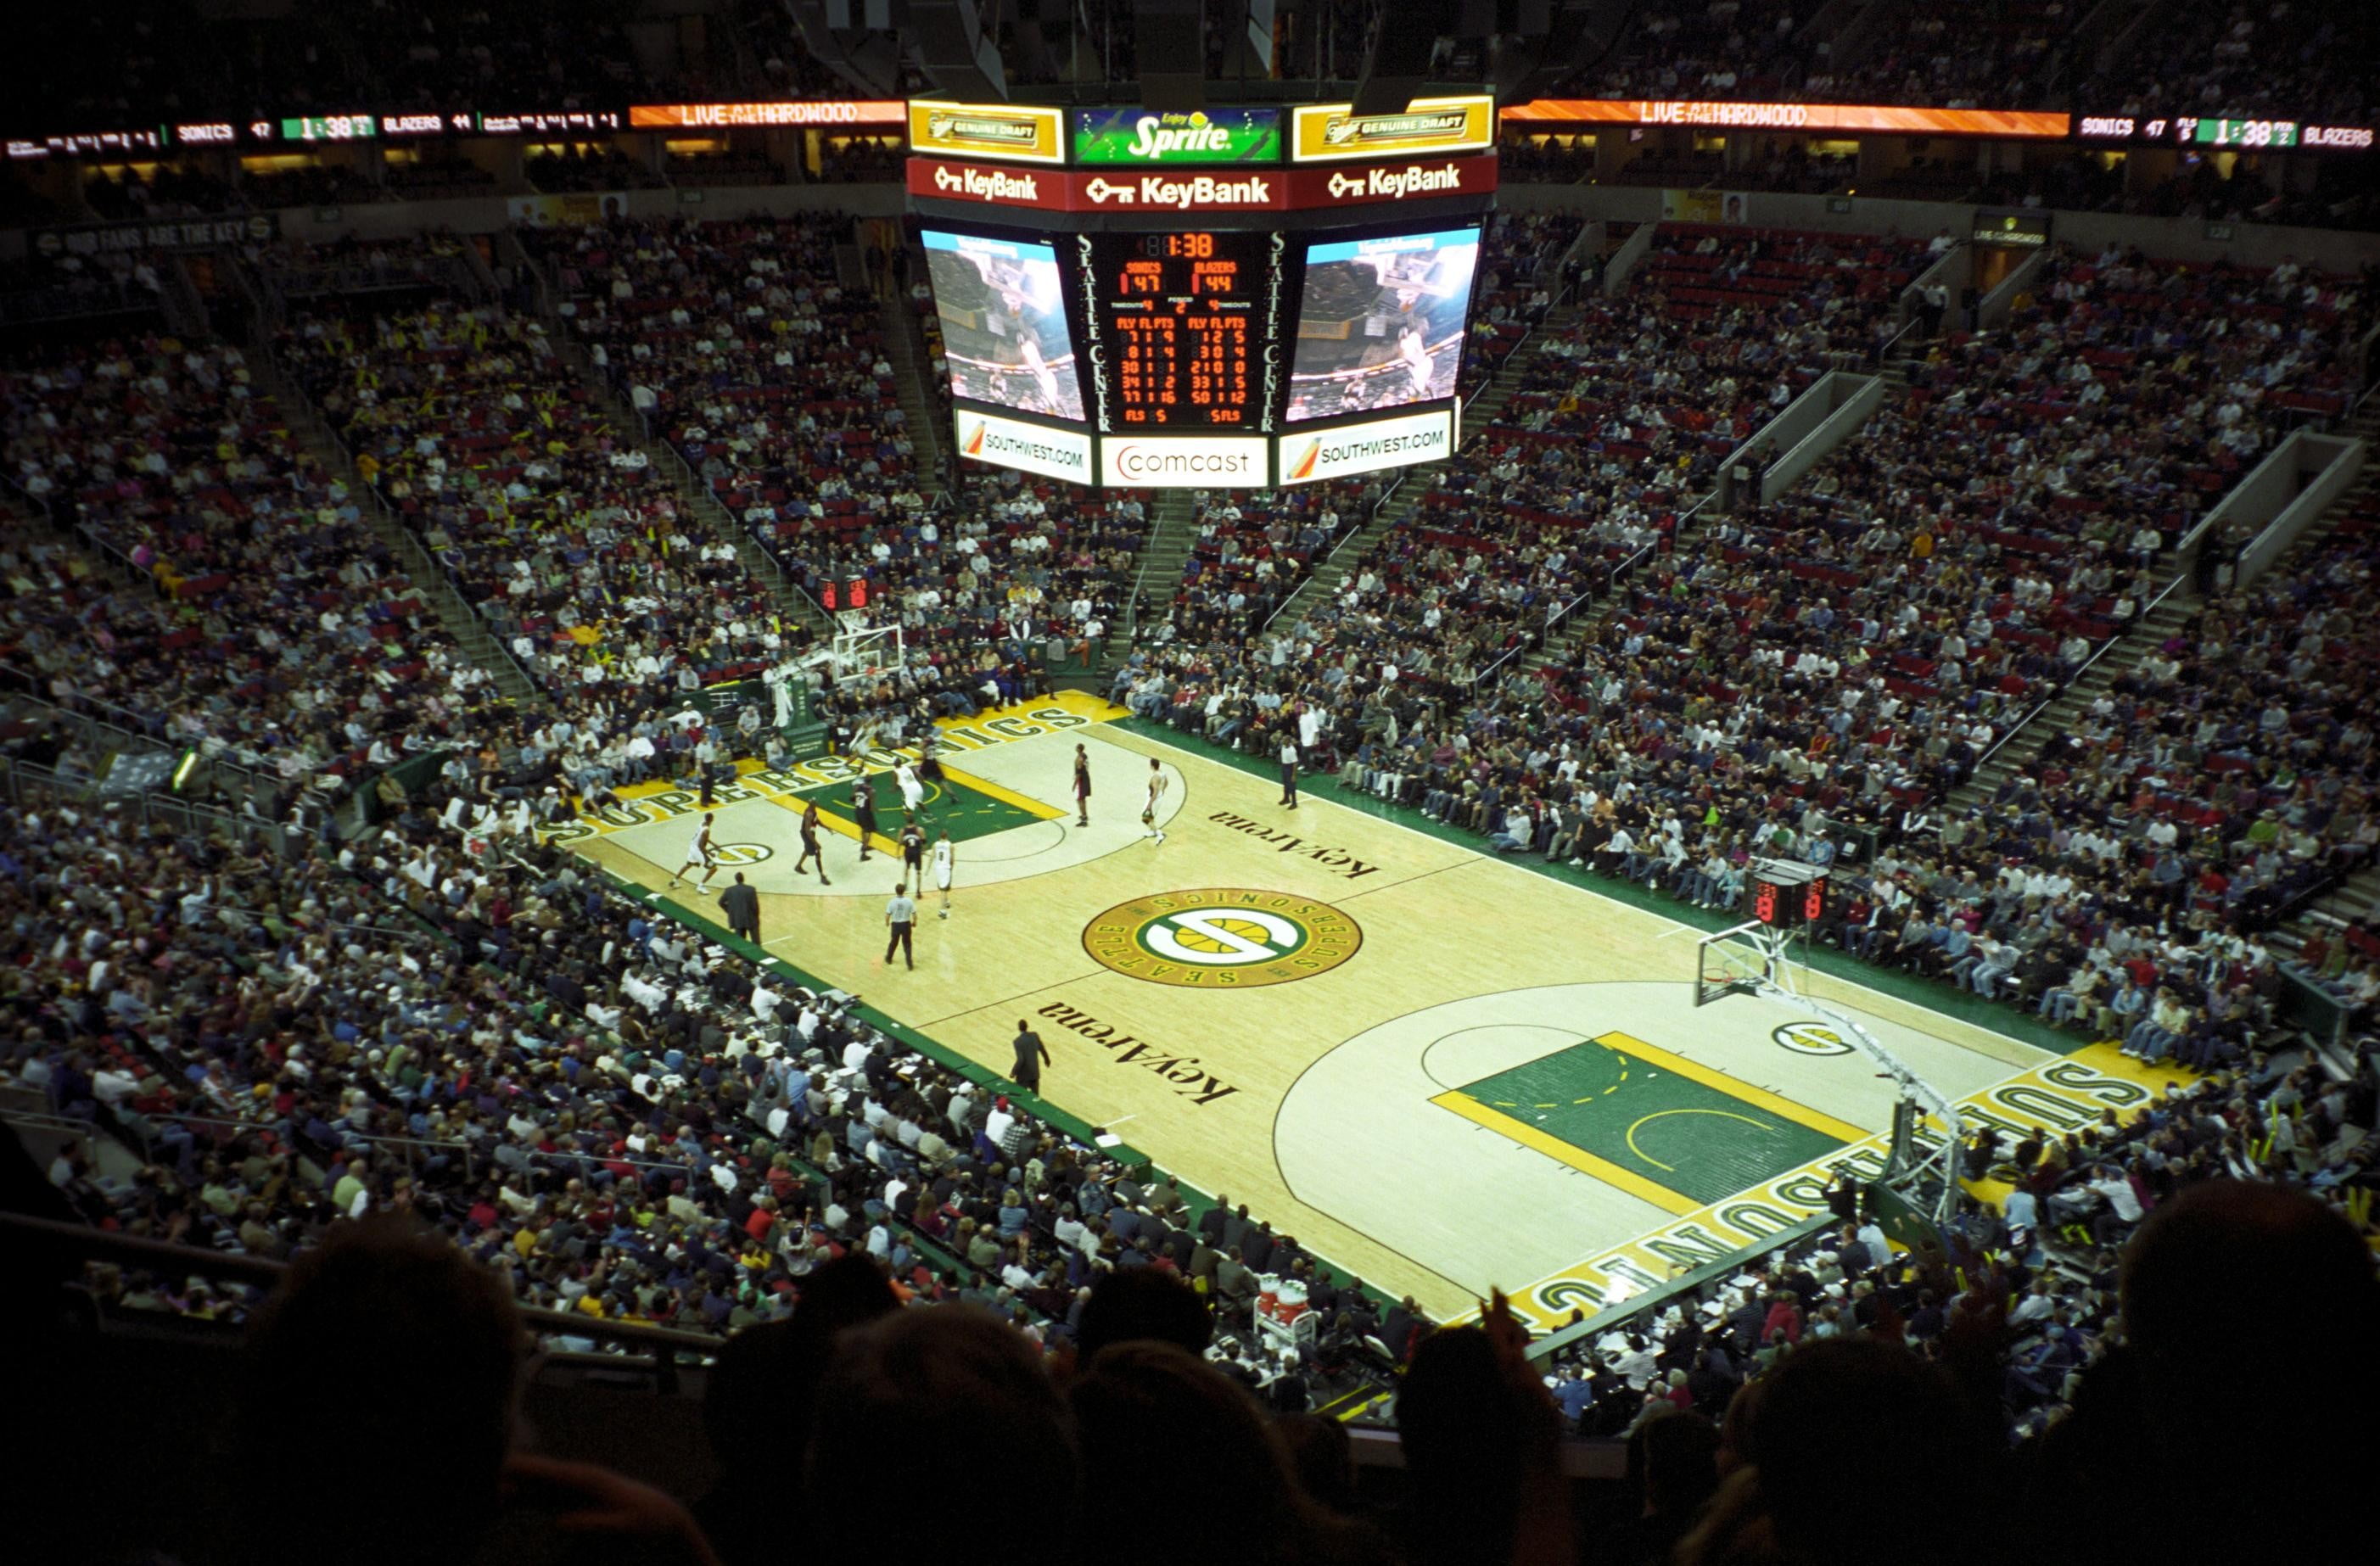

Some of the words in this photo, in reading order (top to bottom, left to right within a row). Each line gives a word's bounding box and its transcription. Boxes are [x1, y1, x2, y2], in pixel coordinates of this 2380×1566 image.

[383, 115, 441, 131] BLAZERS
[452, 115, 471, 128] 44
[680, 104, 727, 126] LIVE
[758, 103, 859, 124] HARDWOOD
[1162, 113, 1188, 125] Enjoy
[1639, 101, 1686, 122] LIVE
[1711, 103, 1808, 126] HARDWOOD
[178, 124, 233, 142] SONICS
[251, 123, 272, 137] 47
[302, 116, 352, 139] 1:38
[954, 121, 996, 135] GENUINE
[999, 125, 1034, 137] DRAFT
[1361, 119, 1417, 134] GENUINE
[1421, 116, 1463, 130] DRAFT
[2080, 118, 2135, 136] SONICS
[2146, 120, 2166, 136] 47
[2213, 120, 2271, 145] 1:38
[1128, 116, 1230, 159] Sprite
[2304, 126, 2374, 148] BLAZERS
[964, 168, 1039, 201] KeyBank
[1369, 164, 1460, 198] KeyBank
[1141, 176, 1270, 209] KeyBank
[181, 223, 210, 243] THE
[1168, 233, 1213, 257] 1:38
[1126, 262, 1162, 274] SONICS
[1194, 262, 1237, 274] BLAZERS
[1077, 233, 1101, 340] SEATTLE
[1134, 275, 1160, 292] 47
[1205, 275, 1231, 292] 44
[1267, 231, 1285, 339] SEATTLE
[1153, 317, 1174, 330] PTS
[1224, 317, 1246, 329] PTS
[1212, 331, 1223, 343] 2
[1234, 331, 1245, 343] 5
[1128, 346, 1139, 358] 8
[1163, 346, 1174, 358] 4
[1235, 346, 1245, 358] 4
[1121, 361, 1140, 373] 30
[1212, 361, 1224, 373] 0
[1089, 344, 1114, 432] CENTER
[1122, 377, 1140, 389] 34
[1165, 377, 1175, 389] 2
[1192, 376, 1210, 389] 33
[1235, 376, 1246, 389] 5
[1261, 344, 1280, 432] CENTER
[1191, 391, 1211, 403] 50
[1230, 391, 1246, 403] 12
[1156, 410, 1167, 422] 5
[1210, 410, 1220, 422] 5
[986, 433, 1084, 467] SOUTHWEST.COM
[1320, 430, 1443, 463] SOUTHWEST.COM
[1208, 811, 1382, 880] KeyArena
[1151, 892, 1348, 970] SUPERSONICS
[1095, 924, 1240, 984] SEATTLE
[1038, 1001, 1240, 1106] KeyArena
